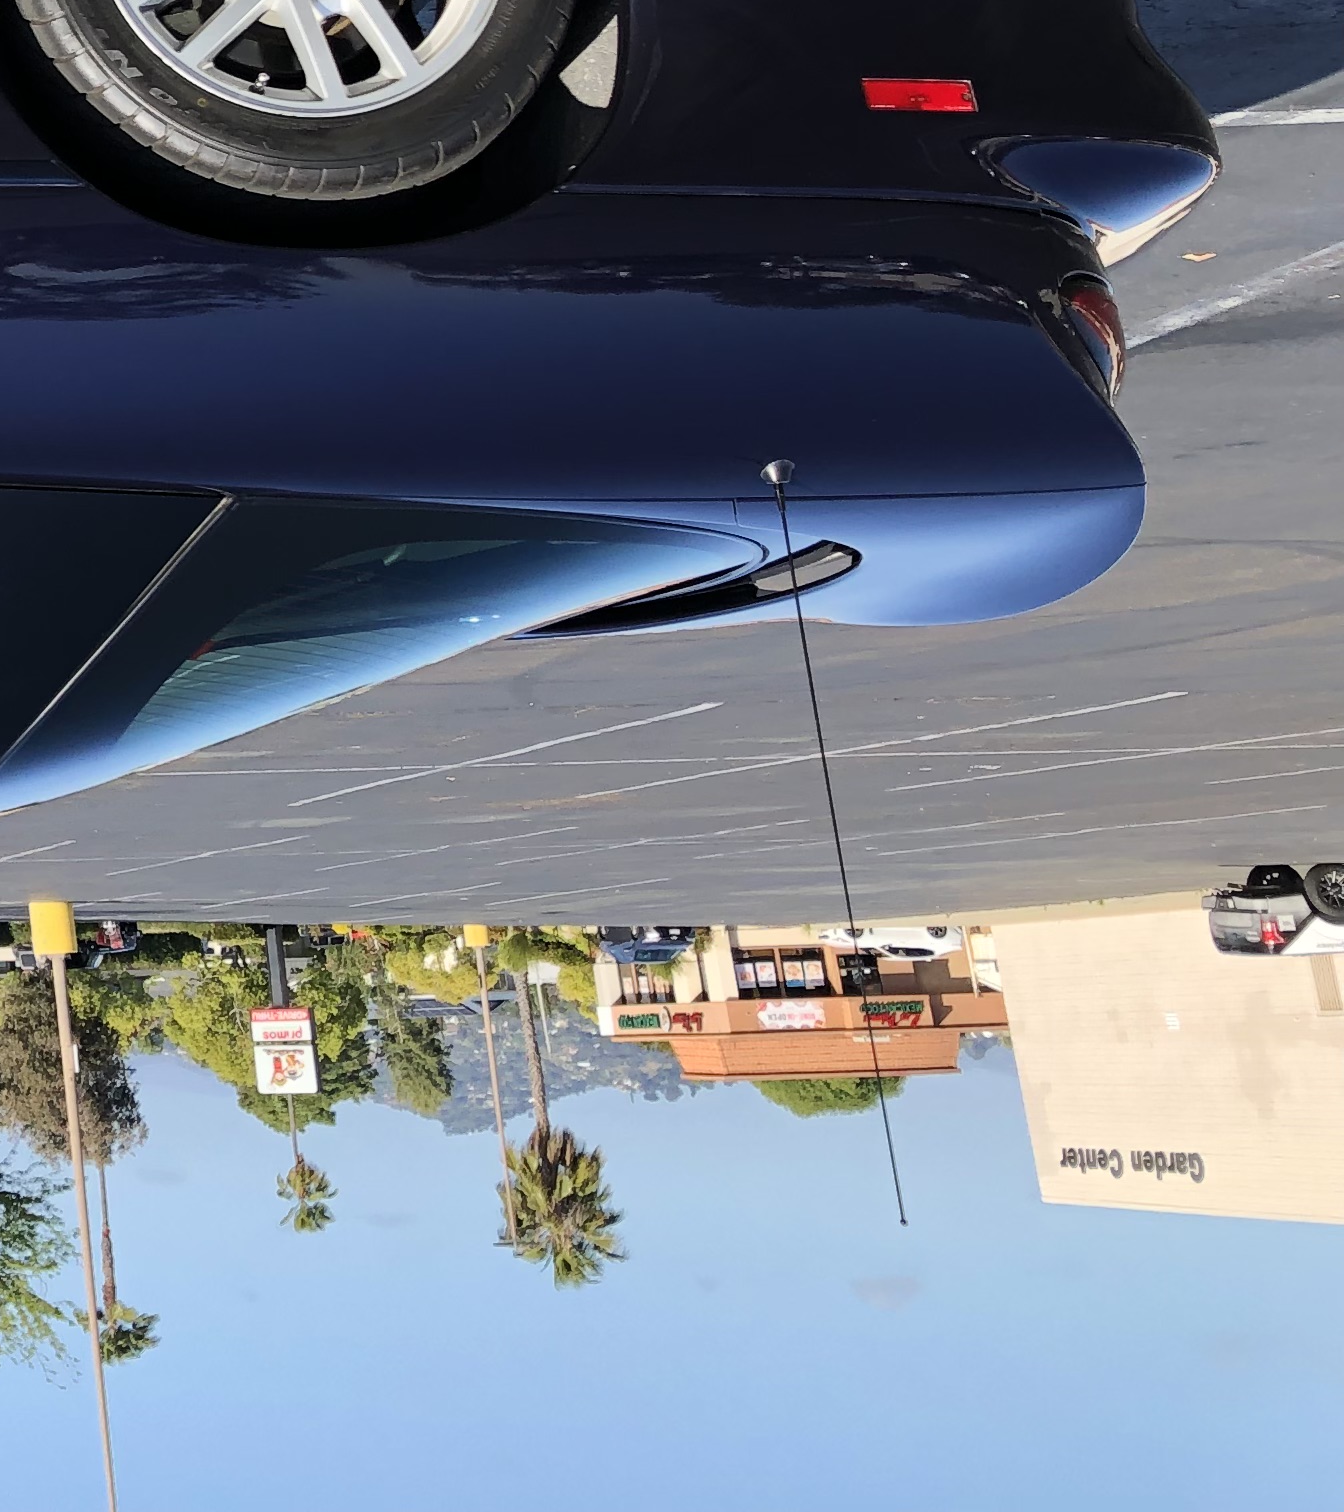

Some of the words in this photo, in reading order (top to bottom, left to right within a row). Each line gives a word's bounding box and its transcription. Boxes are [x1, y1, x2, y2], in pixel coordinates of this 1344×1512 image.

[263, 1026, 302, 1040] primos
[1060, 1148, 1123, 1179] Center
[1131, 1151, 1204, 1184] Garden
